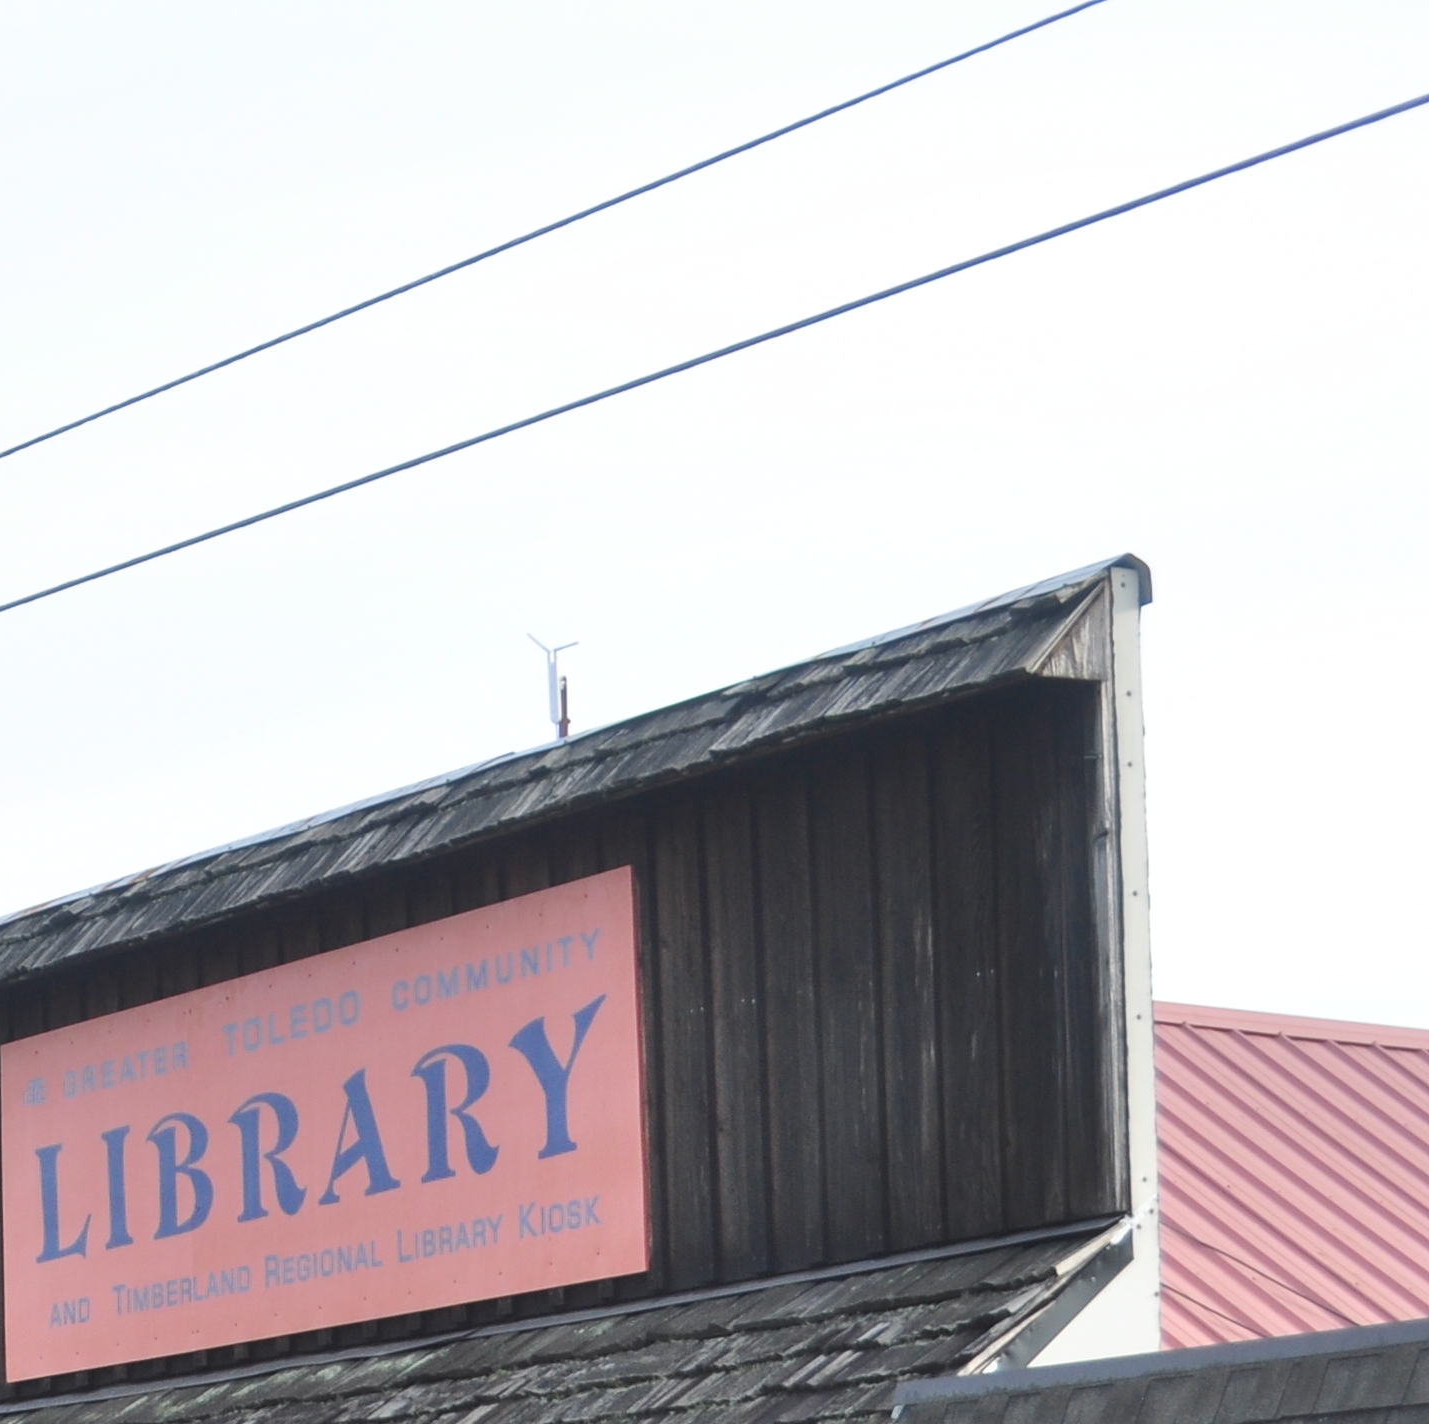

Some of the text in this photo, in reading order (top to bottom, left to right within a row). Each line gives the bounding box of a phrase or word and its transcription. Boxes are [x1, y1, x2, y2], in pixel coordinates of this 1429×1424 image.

[63, 1041, 190, 1100] GREATER
[221, 989, 362, 1058] TOLEDO
[391, 927, 602, 1013] COMMUNITY
[35, 992, 608, 1265] LIBRARY
[49, 1296, 91, 1329] AND
